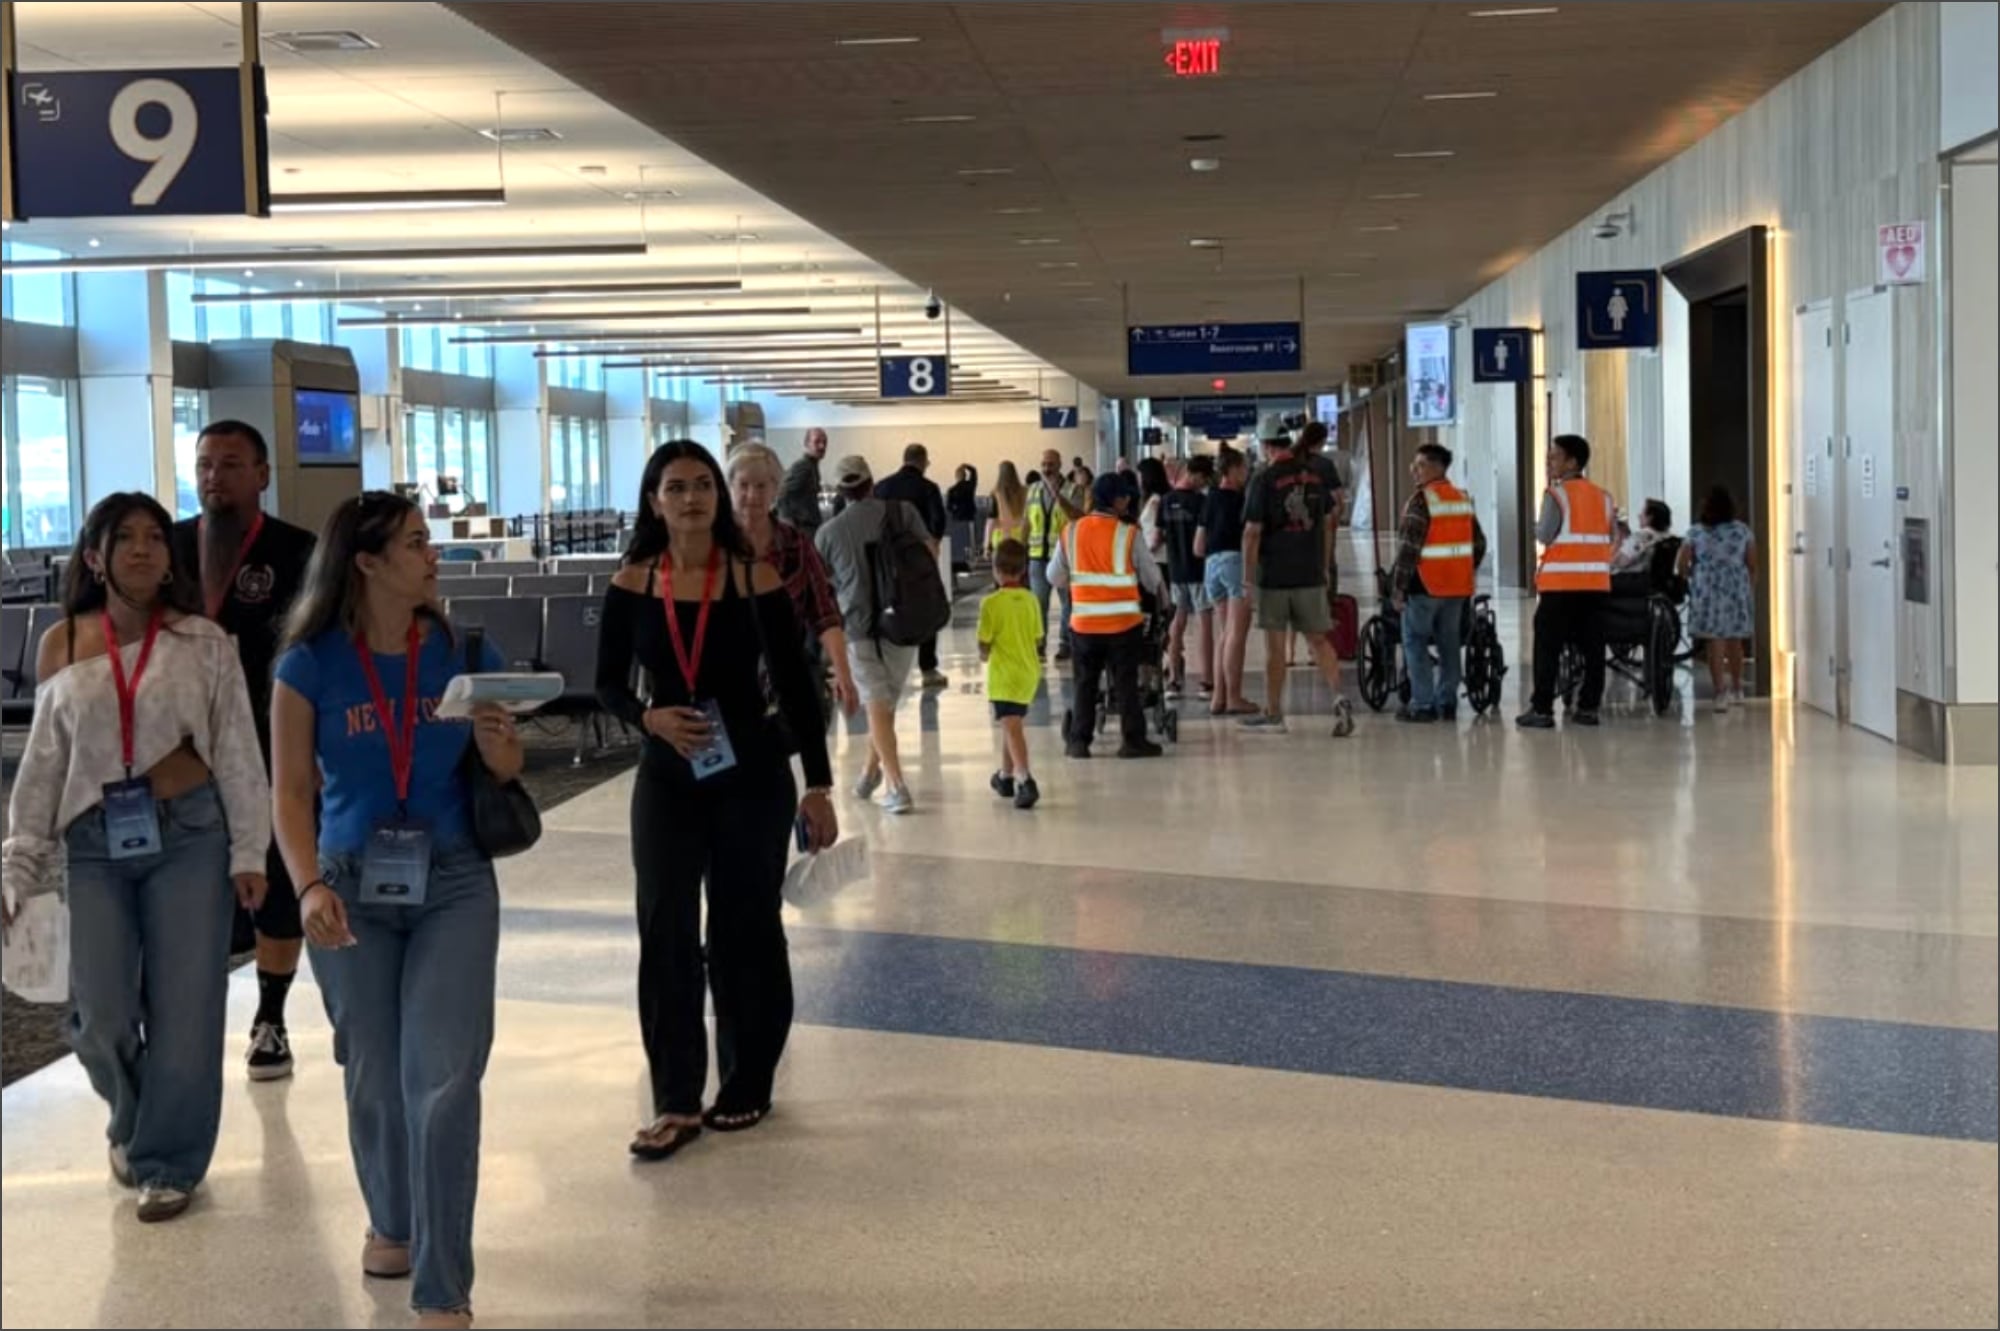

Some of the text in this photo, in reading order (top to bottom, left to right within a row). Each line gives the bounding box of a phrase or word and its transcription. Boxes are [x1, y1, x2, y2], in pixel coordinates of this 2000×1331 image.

[1176, 40, 1219, 74] EXIT
[108, 78, 198, 206] 9
[1886, 225, 1916, 242] AED
[908, 357, 934, 394] 8
[1057, 408, 1069, 427] 7
